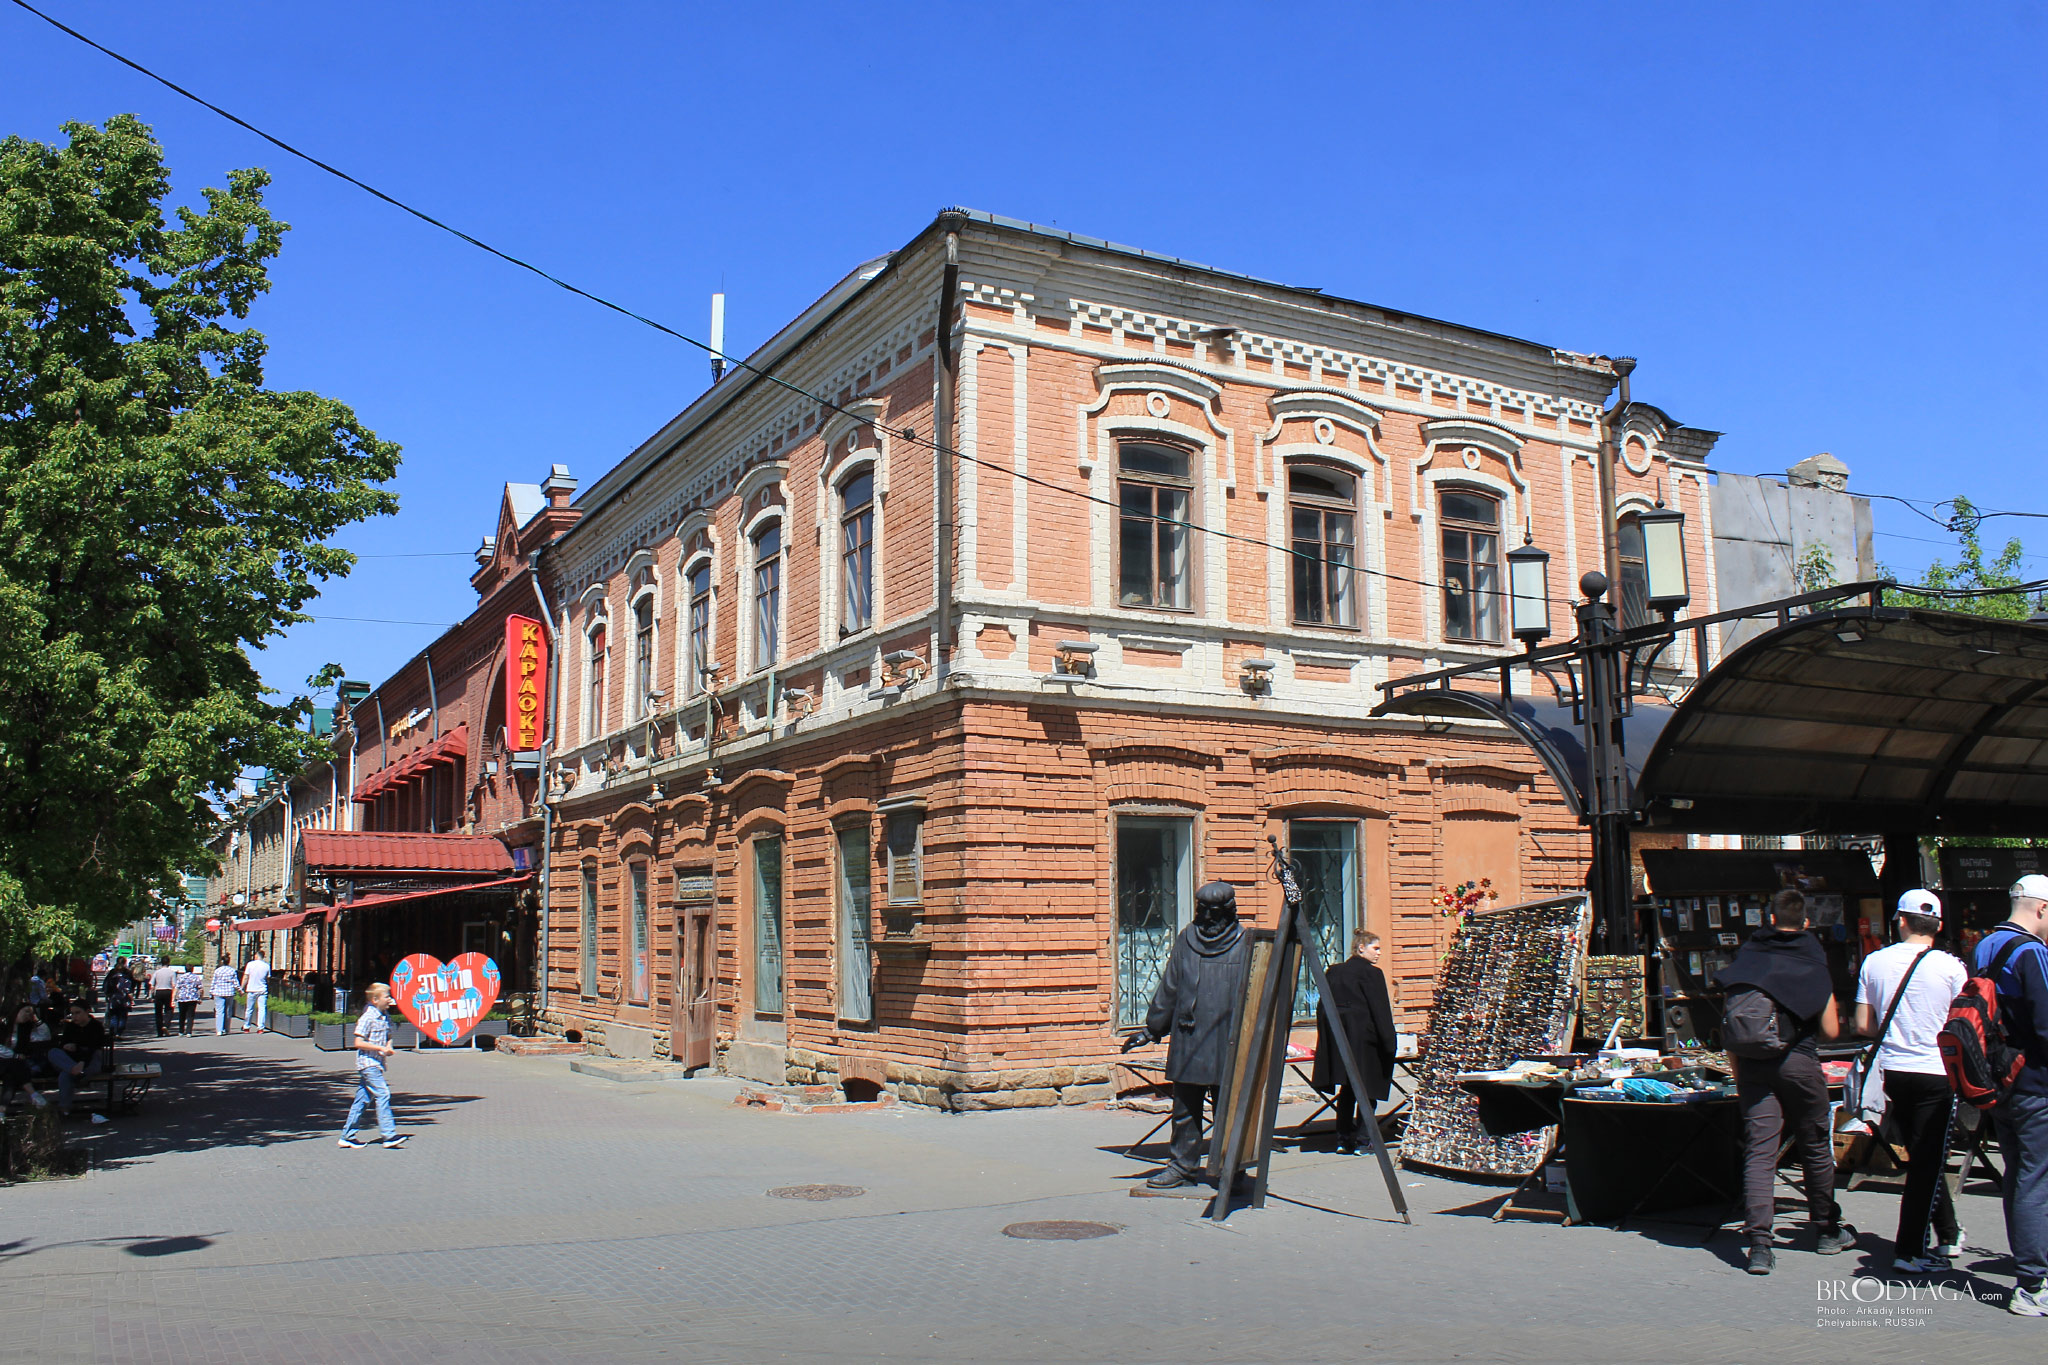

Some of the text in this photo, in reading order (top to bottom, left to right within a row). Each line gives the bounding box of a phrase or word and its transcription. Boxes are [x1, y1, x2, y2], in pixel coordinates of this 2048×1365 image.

[518, 623, 540, 748] КАРАОКЕ
[1959, 858, 1993, 867] МАГНИТЫ
[417, 969, 473, 994] ЭТО ПО
[422, 998, 478, 1024] ЛЮБВИ
